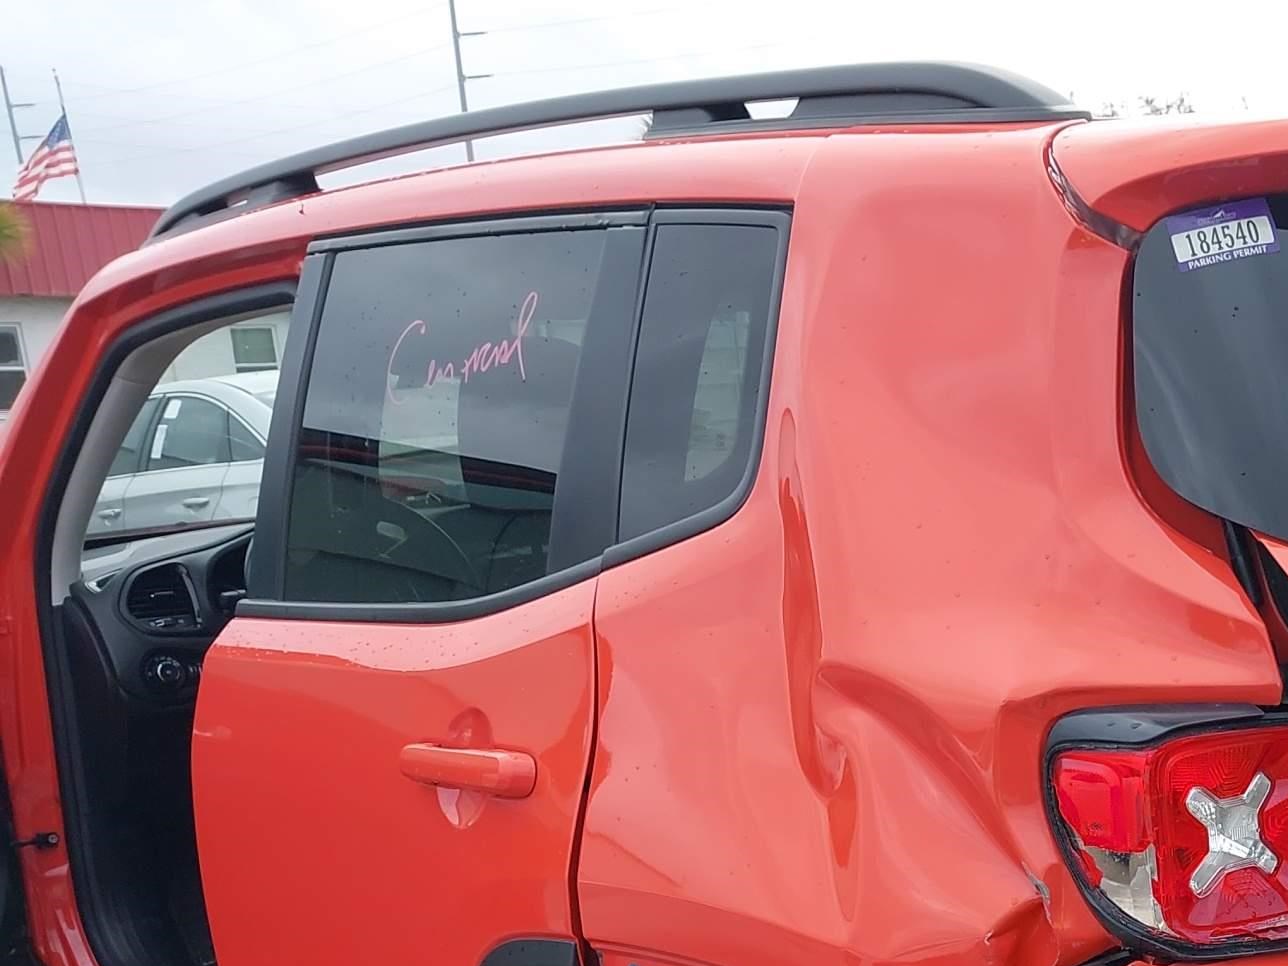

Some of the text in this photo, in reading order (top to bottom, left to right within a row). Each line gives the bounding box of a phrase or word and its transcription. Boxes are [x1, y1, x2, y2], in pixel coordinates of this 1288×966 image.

[1185, 220, 1260, 257] 184540
[1188, 244, 1268, 270] PARKING PERMIT
